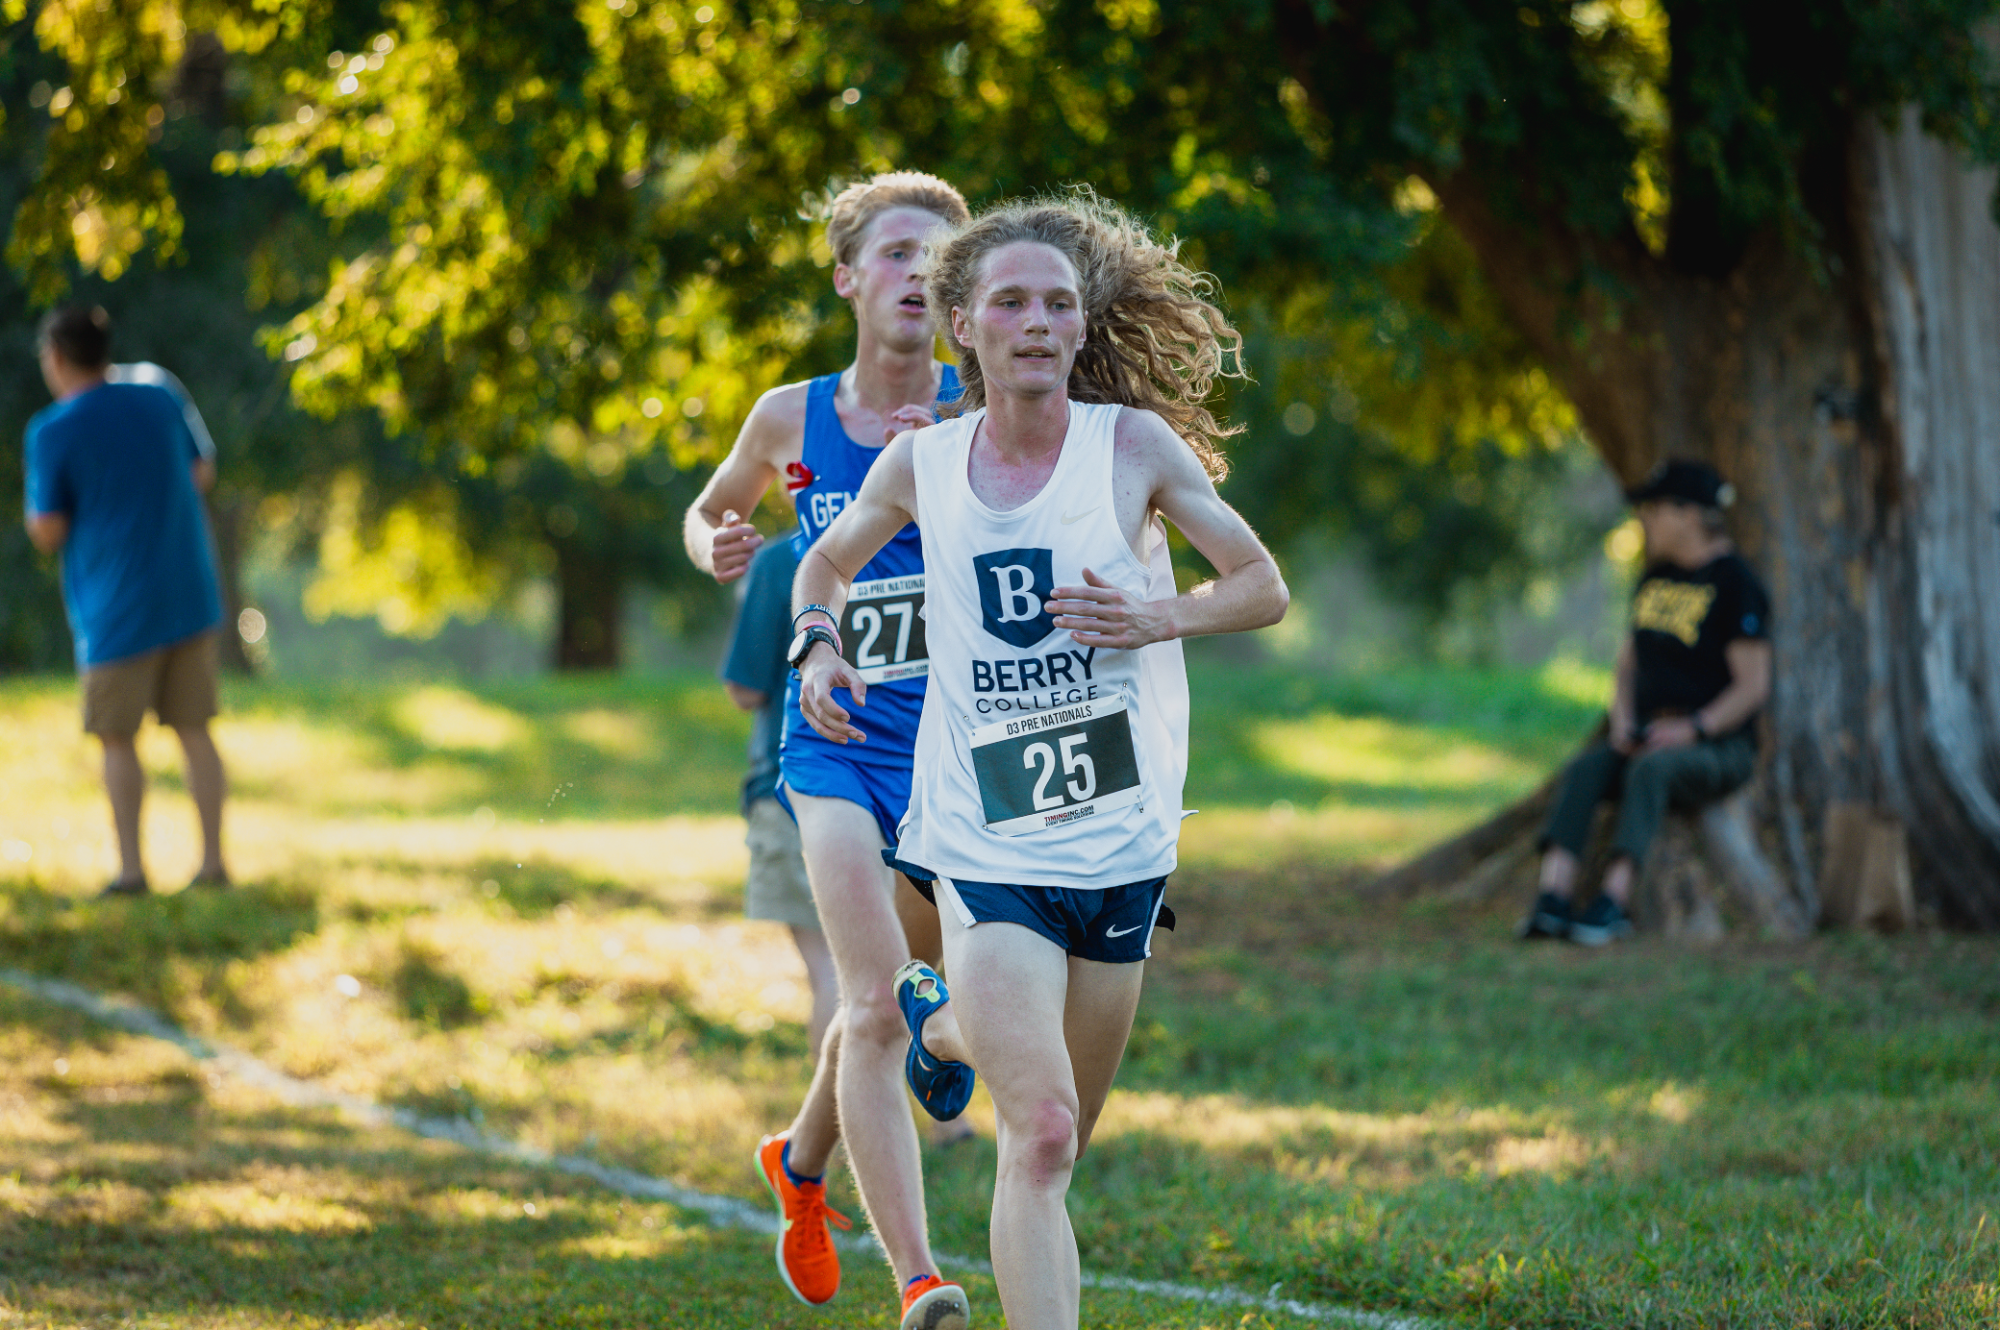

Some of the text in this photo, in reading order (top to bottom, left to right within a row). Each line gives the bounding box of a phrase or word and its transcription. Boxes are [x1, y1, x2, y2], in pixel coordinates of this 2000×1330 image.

[869, 582, 885, 595] PRE
[989, 564, 1042, 623] B
[851, 601, 914, 669] 27
[971, 646, 1096, 692] BERRY
[976, 685, 1098, 713] COLLEGE
[1006, 705, 1093, 736] D3 PRE NATIONALS
[1023, 732, 1097, 811] 25
[1044, 805, 1094, 822] TIMINGINC.COM
